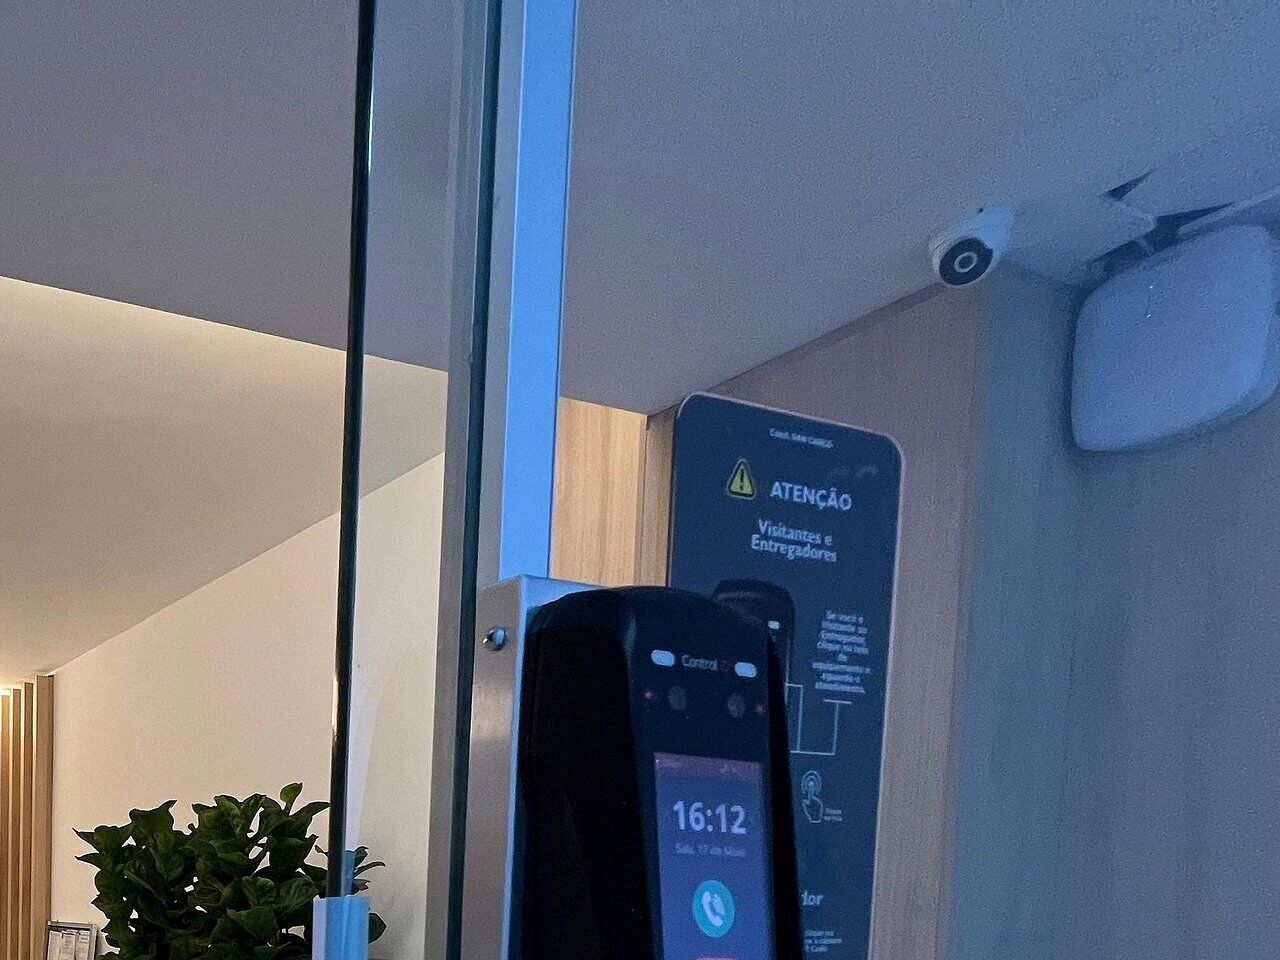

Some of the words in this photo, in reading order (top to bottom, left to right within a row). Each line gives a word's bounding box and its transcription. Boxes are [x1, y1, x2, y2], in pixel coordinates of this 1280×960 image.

[770, 481, 853, 511] ATENÇÃO
[758, 519, 822, 543] Visitantes
[824, 534, 833, 546] e
[751, 534, 837, 562] Entregadores
[673, 800, 747, 835] 16:12
